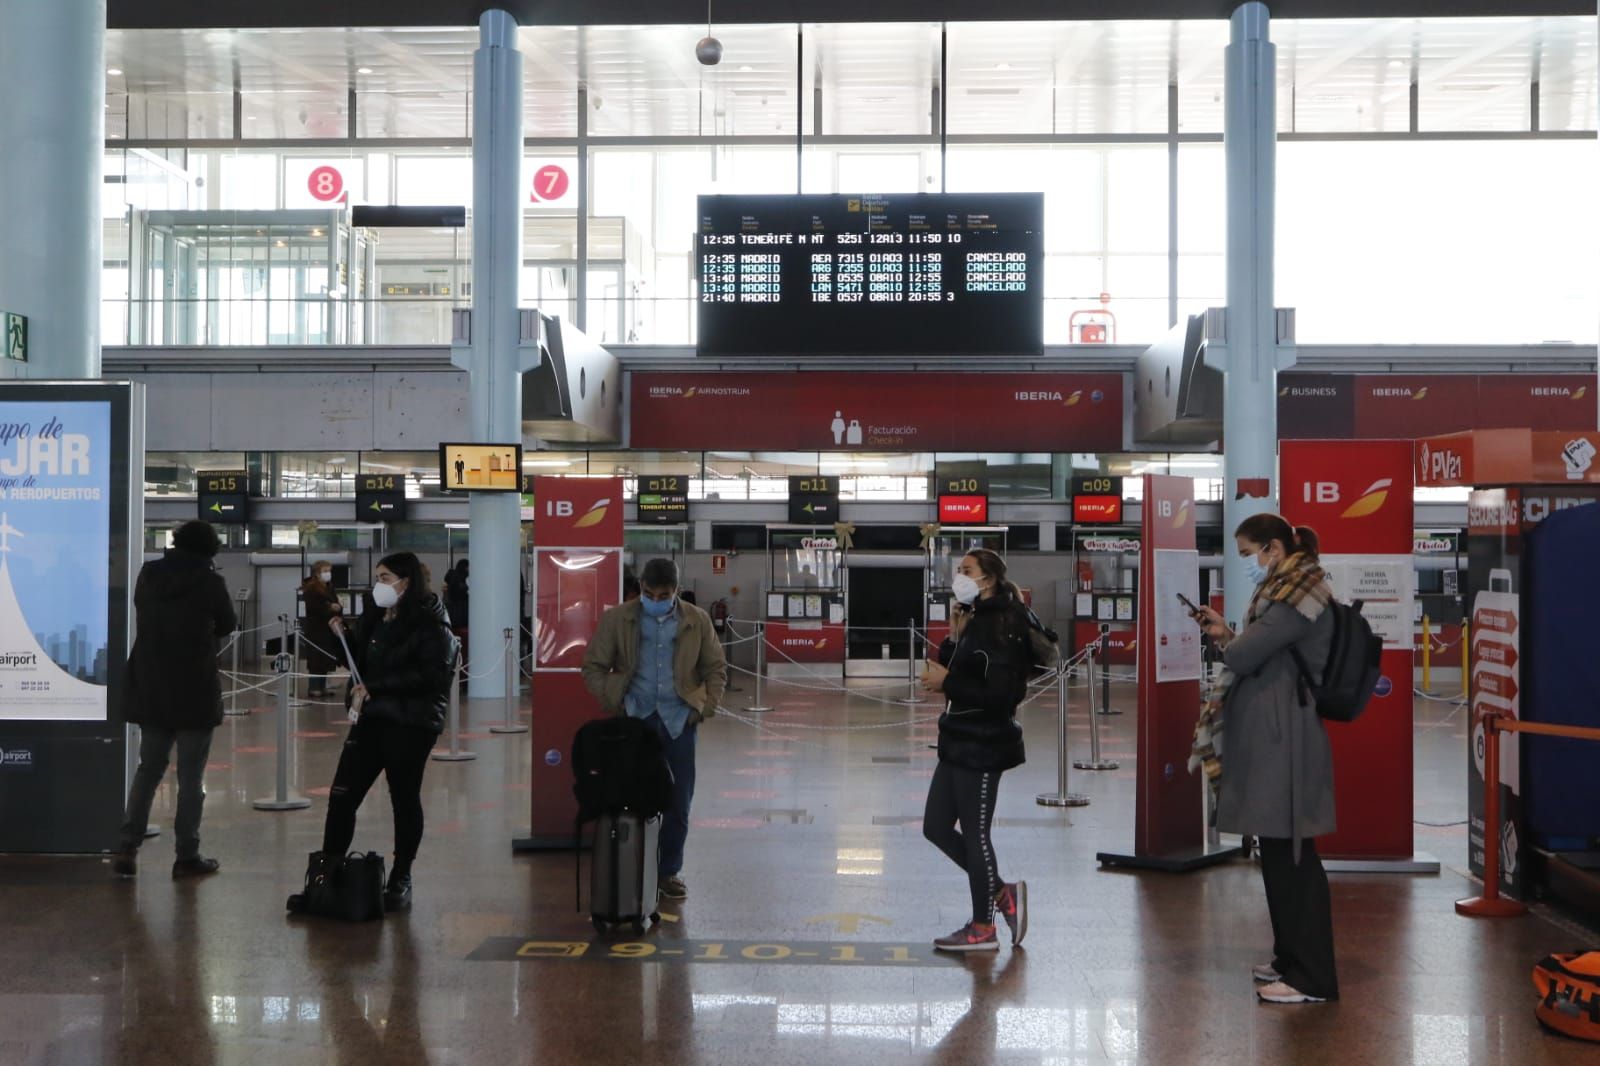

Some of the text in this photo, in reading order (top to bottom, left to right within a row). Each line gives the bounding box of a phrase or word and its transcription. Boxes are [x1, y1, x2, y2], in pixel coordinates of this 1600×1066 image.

[317, 172, 334, 195] 8
[543, 171, 559, 194] 7
[703, 234, 736, 245] 12:35
[741, 234, 793, 245] TENERIFE
[812, 234, 825, 245] NT
[837, 234, 863, 245] 5251
[869, 233, 903, 244] 12A13
[908, 233, 942, 244] 11:50
[948, 233, 962, 244] 10
[703, 253, 1026, 263] 12:35 MADRID AEA 7315 01A03 11:50 CANCELADO
[703, 263, 1026, 273] 12:35 MADRID ARG 7355 01A03 11:50 CANCELADO
[703, 273, 1026, 283] 13:40 MADRID IBE 0535 08A10 12:55 CANCELADO
[703, 282, 1026, 293] 13:40 MADRID LAN 5471 08A10 12:55 CANCELADO
[703, 292, 955, 302] 21:40 MADRID IBE 0537 08A10 20:55 3
[649, 386, 683, 395] IBERIA
[1015, 391, 1063, 401] IBERIA
[1291, 387, 1337, 396] BUSINESS
[1372, 388, 1412, 396] IBERIA
[1531, 387, 1570, 396] IBERIA
[39, 416, 63, 439] de
[868, 424, 918, 435] Facturación
[1432, 450, 1462, 480] PV21
[220, 478, 236, 491] 15
[377, 476, 394, 489] 14
[660, 477, 678, 490] 12
[811, 478, 828, 491] 11
[960, 479, 977, 492] 10
[1093, 478, 1111, 492] 09
[11, 487, 101, 500] AEROPUERTOS
[1303, 481, 1341, 503] IB
[546, 500, 574, 517] IB
[1158, 500, 1172, 517] IB
[783, 638, 815, 646] IBERIA
[0, 652, 36, 667] airport
[4, 750, 32, 762] airport
